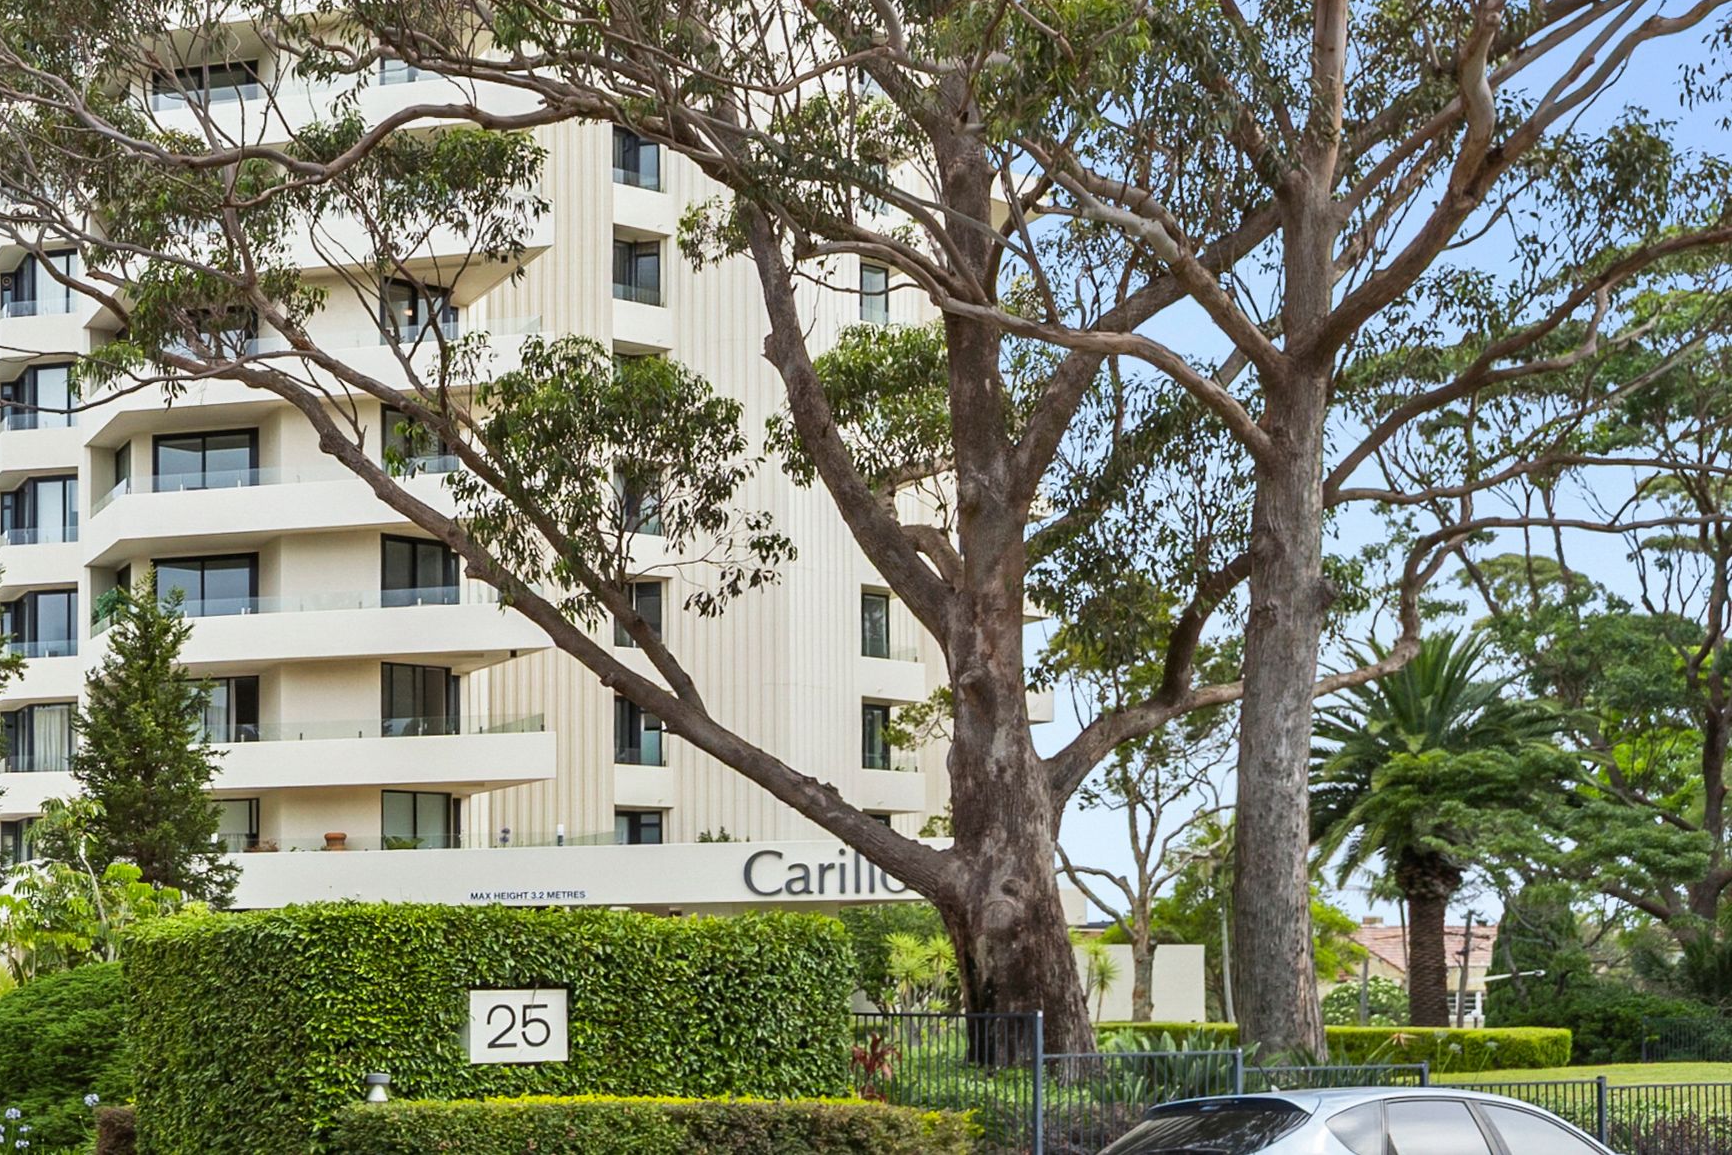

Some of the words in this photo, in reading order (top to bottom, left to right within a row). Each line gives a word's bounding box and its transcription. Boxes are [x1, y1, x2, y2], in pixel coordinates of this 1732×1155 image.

[743, 848, 908, 896] Carillo
[470, 892, 490, 900] MAX
[494, 891, 529, 900] HEIGHT
[531, 891, 544, 899] 3.2
[547, 891, 586, 899] METRES
[486, 1003, 551, 1049] 25
